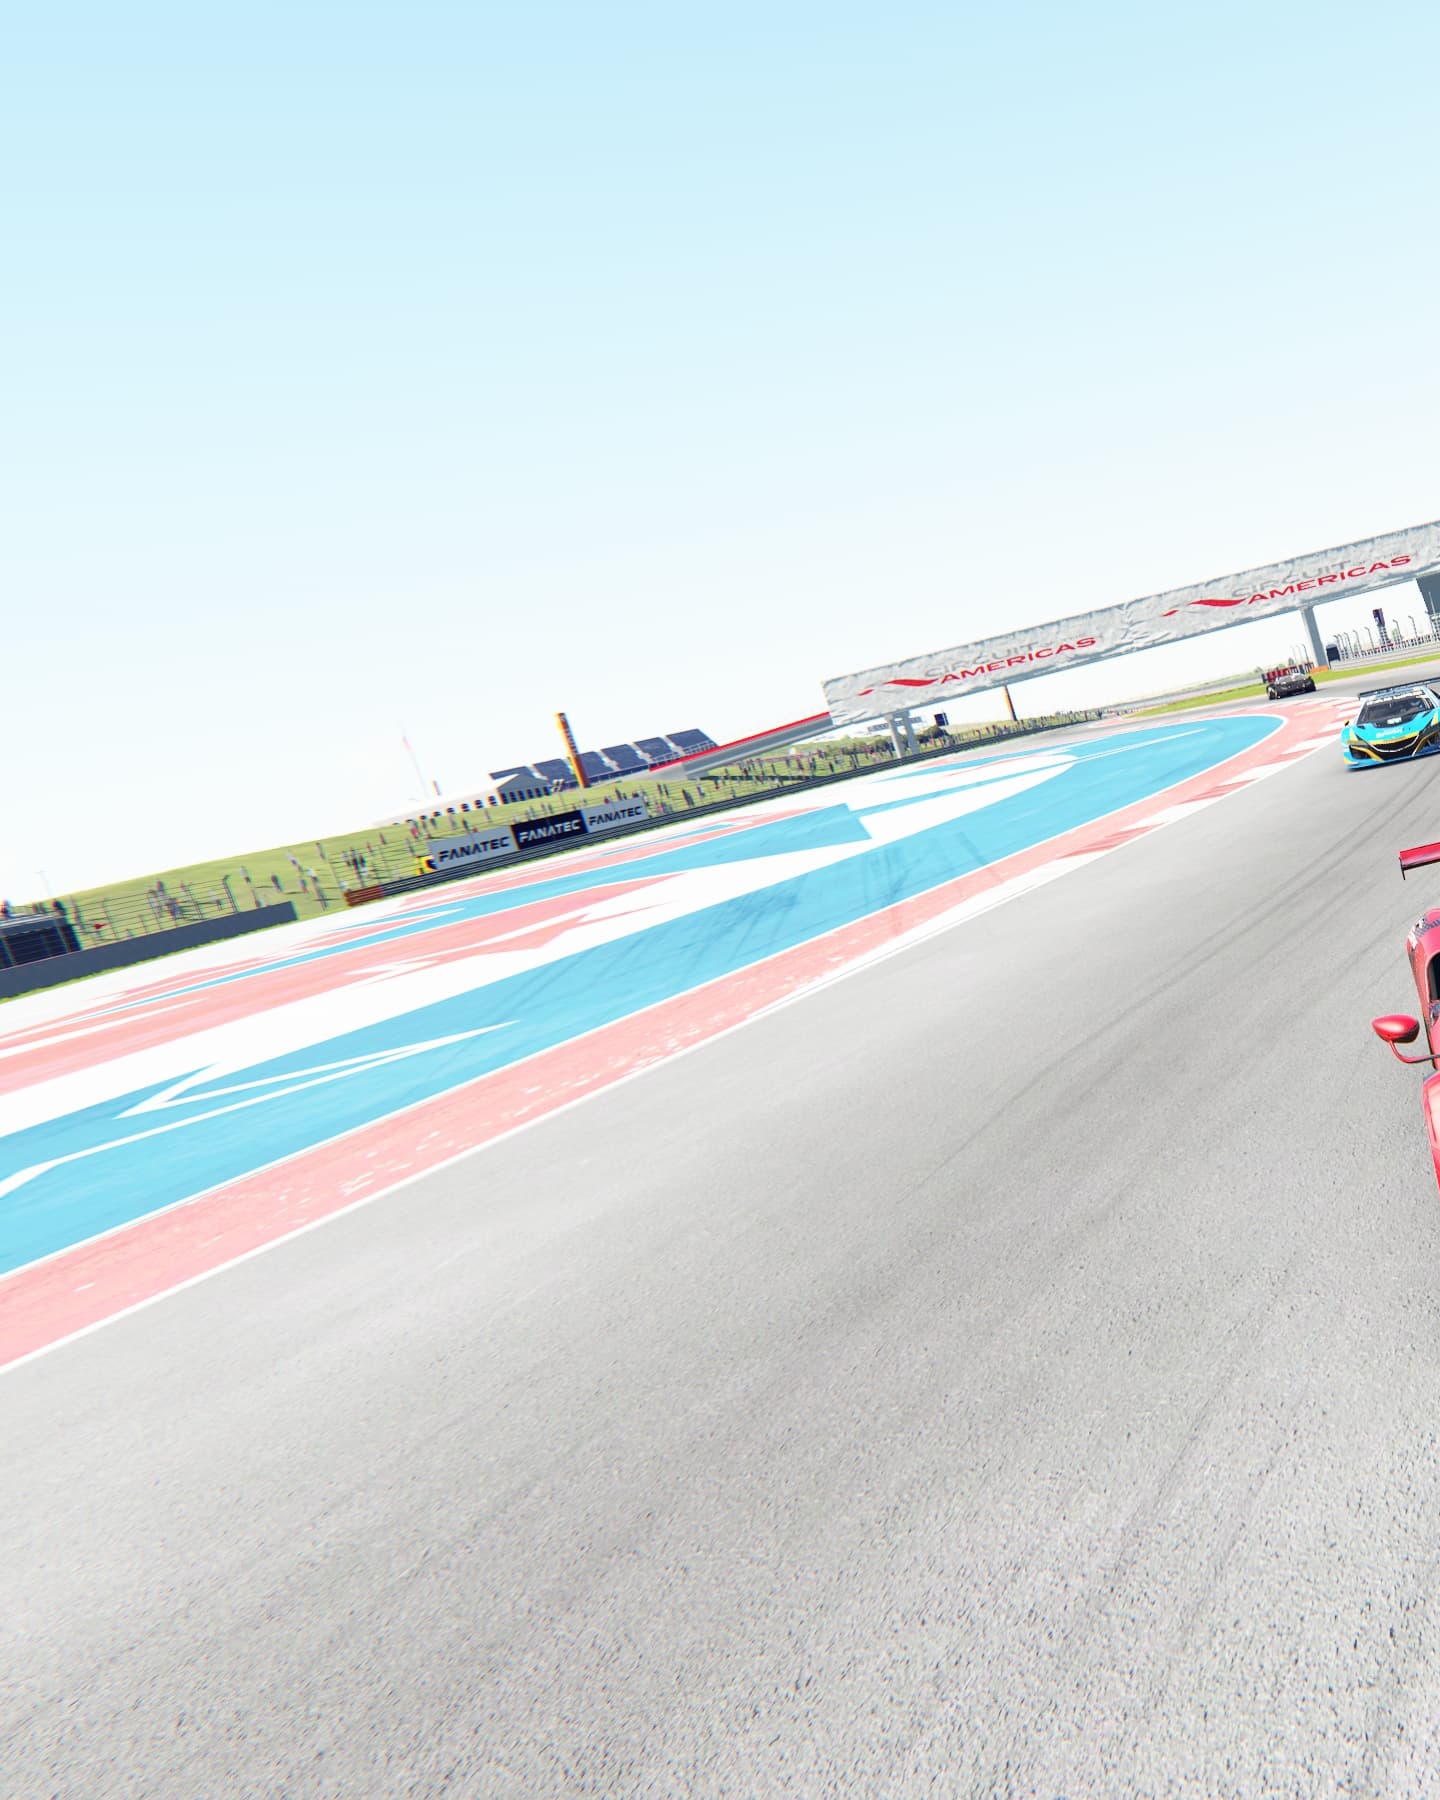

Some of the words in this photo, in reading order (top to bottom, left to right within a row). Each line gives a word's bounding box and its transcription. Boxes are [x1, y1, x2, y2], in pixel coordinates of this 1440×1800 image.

[1231, 559, 1352, 599] CIRCUIT
[1248, 555, 1412, 605] AMERICAS
[940, 637, 1097, 684] AMERICAS
[519, 819, 581, 843] FANATEC
[588, 805, 643, 826] FANATEC
[438, 836, 510, 862] FANATEC
